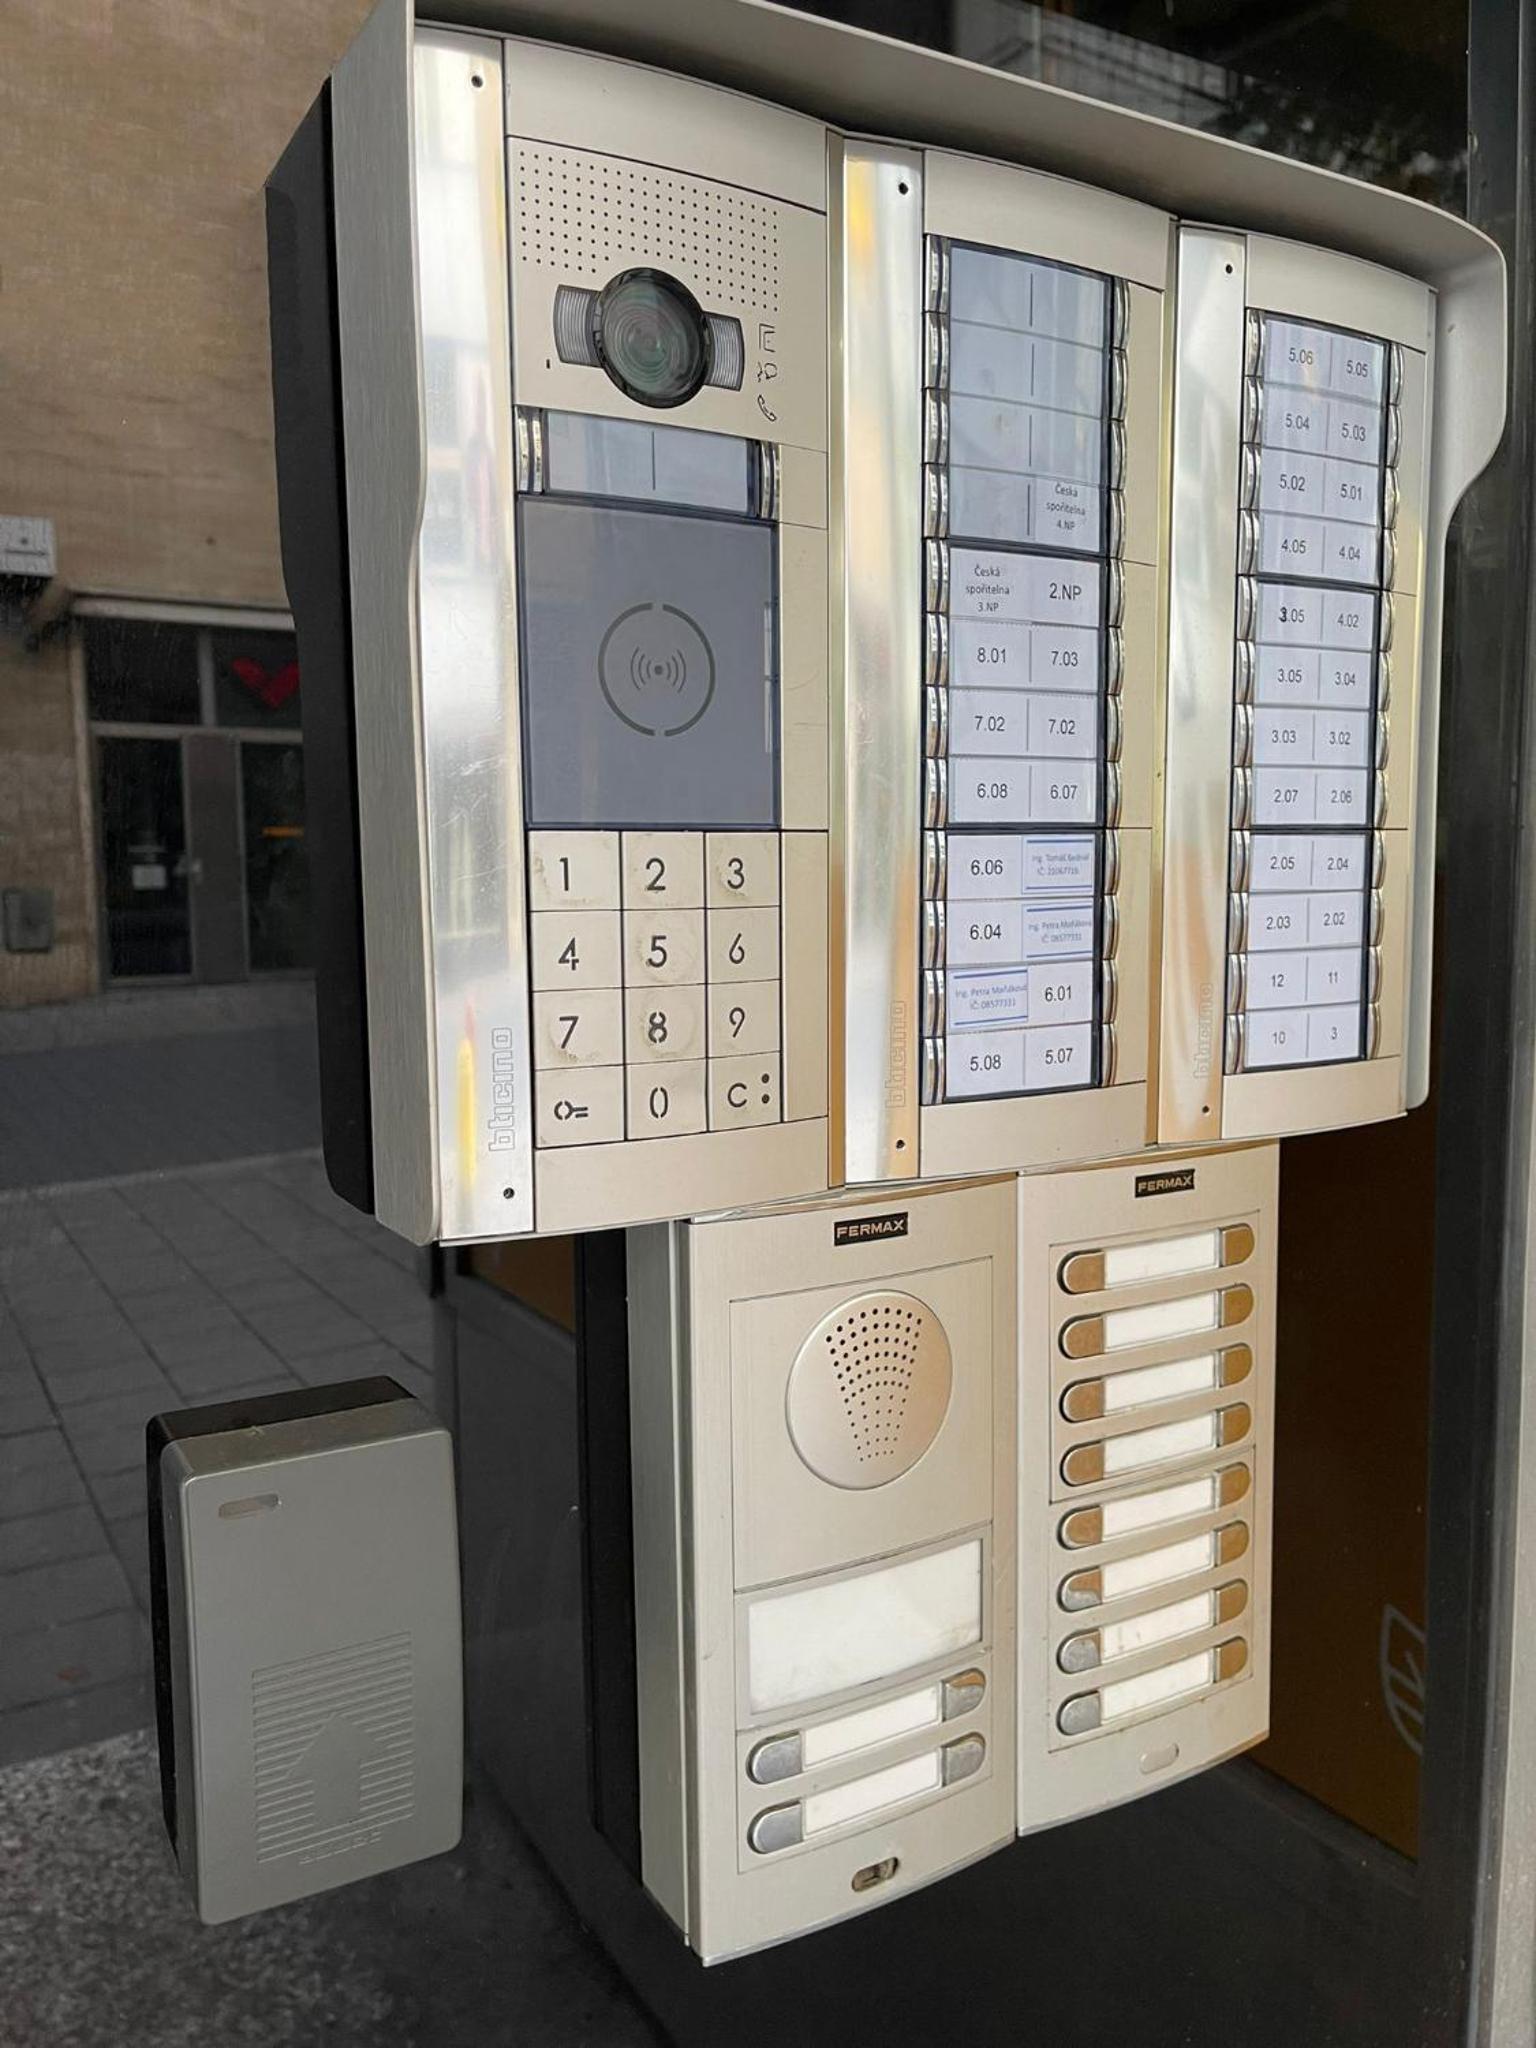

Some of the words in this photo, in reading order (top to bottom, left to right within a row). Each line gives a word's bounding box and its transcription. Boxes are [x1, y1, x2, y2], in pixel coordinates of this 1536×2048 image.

[1288, 347, 1313, 365] 5.06
[1346, 360, 1368, 377] 5.05
[1285, 413, 1310, 430] 5.04
[1341, 423, 1366, 441] 5.03
[1054, 483, 1078, 498] Česká
[1279, 474, 1306, 492] 5.02
[1340, 484, 1362, 501] 5.01
[1045, 501, 1086, 516] spořitelna
[1056, 520, 1076, 531] 4.NP
[1281, 539, 1306, 554] 4.05
[1339, 546, 1361, 561] 4.04
[974, 564, 1001, 578] Česká
[965, 583, 1010, 596] spořitelna
[1049, 583, 1082, 601] 2.NP
[977, 602, 999, 613] 3.NP
[1278, 606, 1305, 623] 3.05
[1337, 614, 1359, 628] 4.02
[976, 647, 1007, 663] 8.01
[1051, 651, 1078, 667] 7.03
[1277, 668, 1302, 683] 3.05
[1334, 671, 1356, 686] 3.04
[974, 716, 1005, 732] 7.02
[1048, 719, 1076, 735] 7.02
[1271, 730, 1296, 744] 3.03
[1329, 731, 1351, 745] 3.02
[976, 783, 1008, 799] 6.08
[1050, 784, 1078, 800] 6.07
[1273, 789, 1298, 803] 2.07
[1331, 790, 1352, 804] 2.06
[970, 859, 1003, 876] 6.06
[1270, 856, 1295, 870] 2.05
[1327, 857, 1348, 871] 2.04
[559, 857, 569, 891] 1
[645, 857, 666, 891] 2
[727, 857, 745, 890] 3
[1266, 916, 1291, 930] 2.03
[1323, 912, 1345, 926] 2.02
[970, 924, 1002, 940] 6.04
[558, 937, 580, 971] 4
[646, 935, 667, 968] 5
[729, 933, 745, 965] 6
[1271, 974, 1285, 987] 12
[1328, 971, 1338, 983] 11
[1045, 985, 1072, 1002] 6.01
[648, 1011, 668, 1044] 8
[729, 1007, 745, 1038] 9
[558, 1015, 580, 1049] 7
[1272, 1031, 1286, 1044] 10
[1331, 1027, 1338, 1040] 3
[970, 1054, 1002, 1072] 5.08
[1045, 1047, 1073, 1065] 5.07
[488, 1027, 516, 1151] bticino
[727, 1082, 747, 1108] C
[649, 1086, 669, 1119] 0
[1137, 1173, 1193, 1194] FERMAX
[836, 1218, 905, 1241] FERMAX
